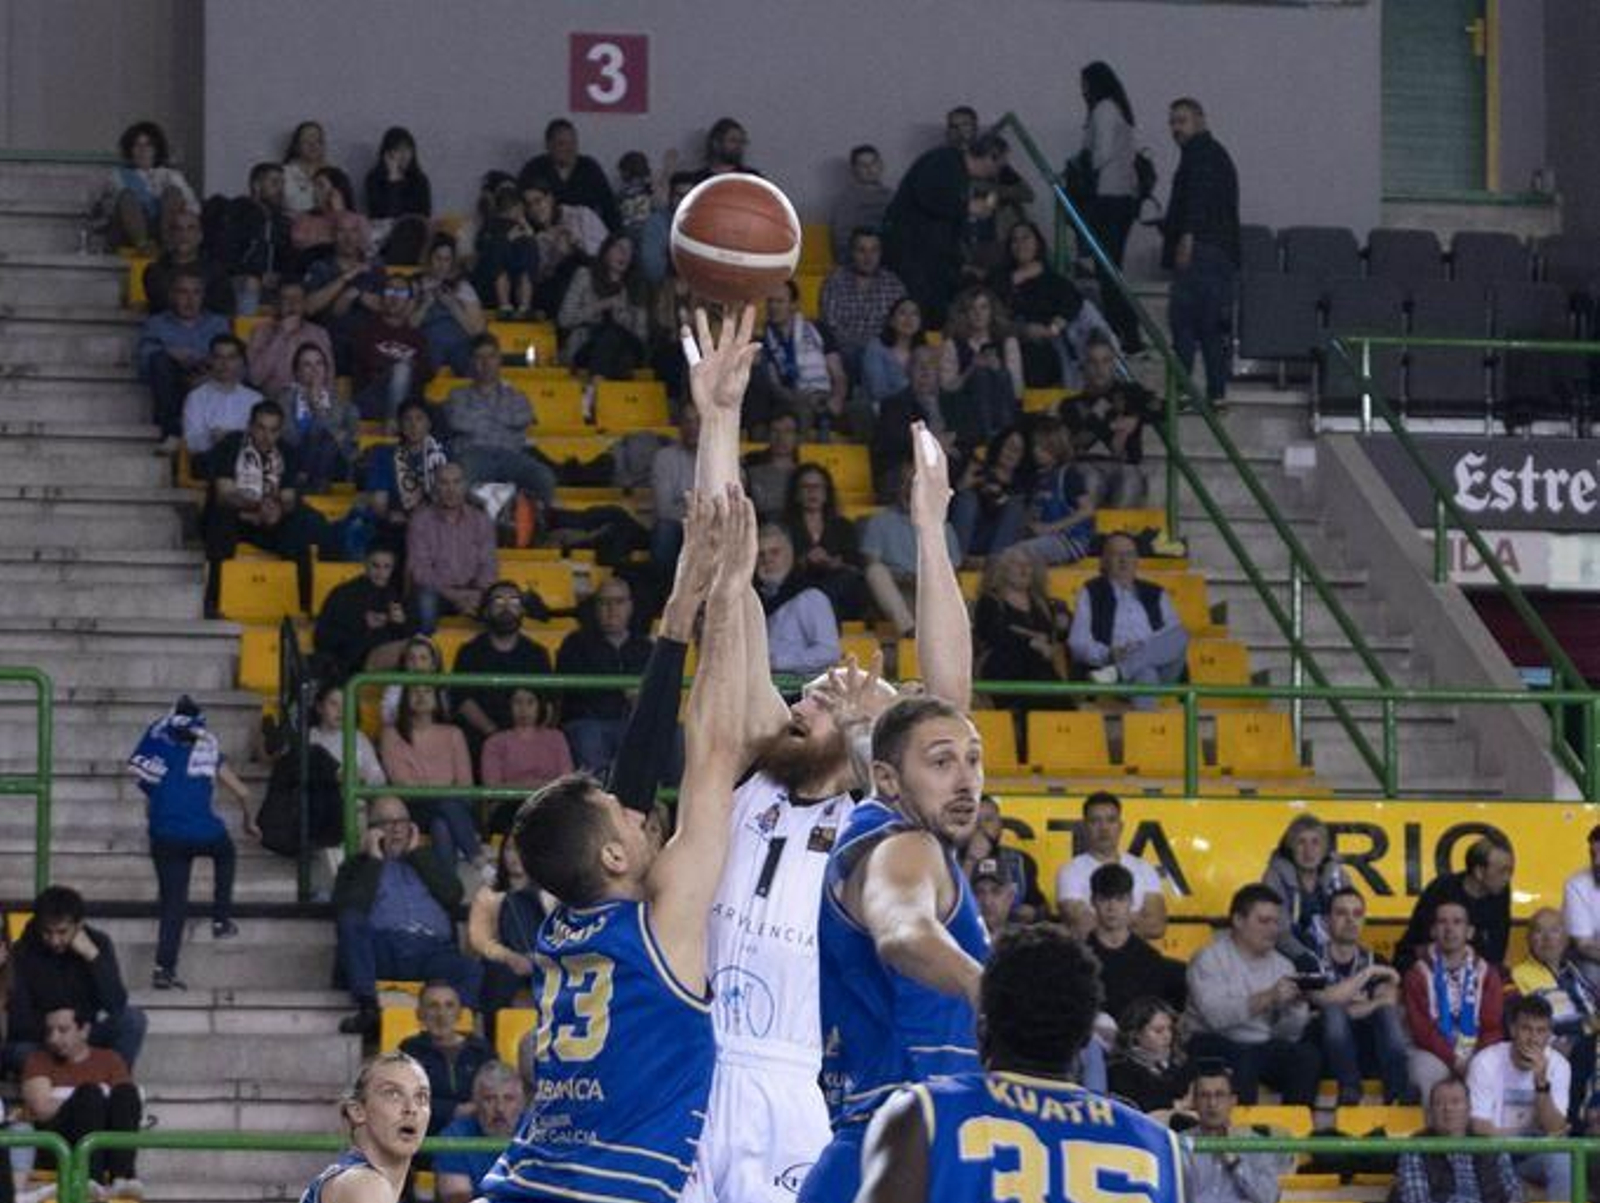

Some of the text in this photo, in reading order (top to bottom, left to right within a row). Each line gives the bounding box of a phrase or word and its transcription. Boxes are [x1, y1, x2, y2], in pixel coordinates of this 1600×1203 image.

[587, 42, 627, 105] 3
[1453, 451, 1600, 514] Estre
[755, 837, 786, 896] 1
[986, 1076, 1115, 1126] KUATH
